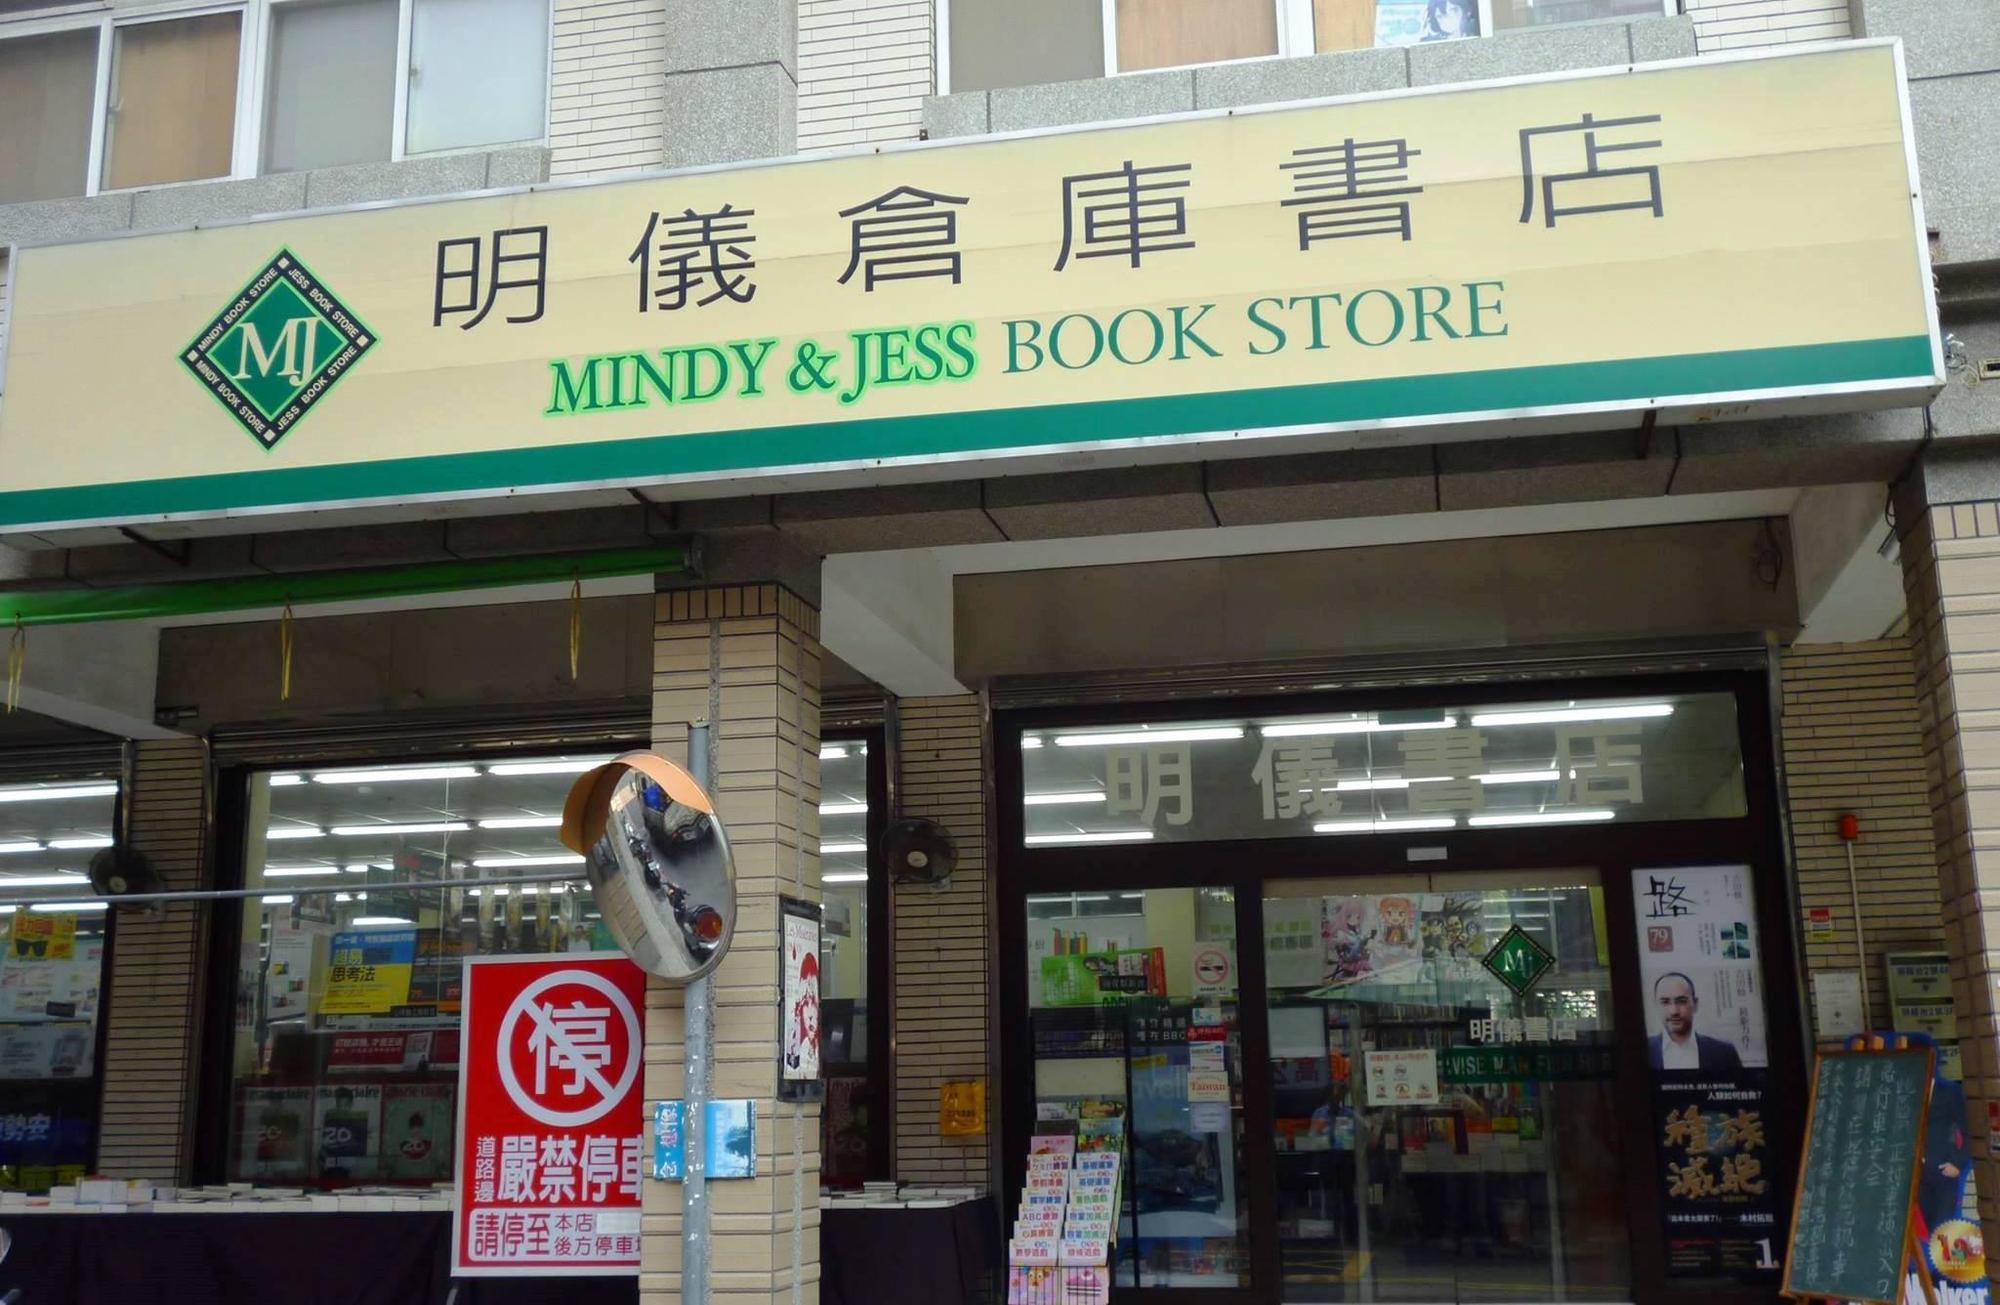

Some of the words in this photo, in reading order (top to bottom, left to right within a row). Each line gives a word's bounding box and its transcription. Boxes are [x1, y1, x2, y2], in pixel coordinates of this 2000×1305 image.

[431, 112, 1664, 330] 明儀倉庫書店
[198, 324, 224, 352] MINDY
[223, 297, 250, 324] BOOK
[249, 267, 278, 298] STORE
[287, 268, 310, 289] JESS
[308, 288, 333, 313] BOOK
[331, 310, 359, 339] STORE
[232, 316, 321, 387] MJ
[544, 339, 778, 415] MINDY
[1002, 303, 1223, 374] BOOK
[1246, 281, 1510, 356] STORE
[195, 359, 219, 386] MINDY
[216, 383, 241, 408] BOOK
[238, 405, 266, 434] STORE
[277, 405, 301, 431] JESS
[300, 377, 328, 404] BOOK
[327, 345, 358, 377] STORE
[1105, 723, 1644, 826] 明儀書店
[1642, 875, 1700, 919] 路
[1650, 928, 1668, 945] 79
[331, 966, 376, 983] 思考法
[527, 1000, 611, 1096] 停
[1469, 1016, 1577, 1043] 明儀書店
[473, 1136, 497, 1203] 道路邊
[473, 1211, 552, 1258] 請停至
[554, 1211, 594, 1233] 本店
[554, 1235, 642, 1257] 後方停車
